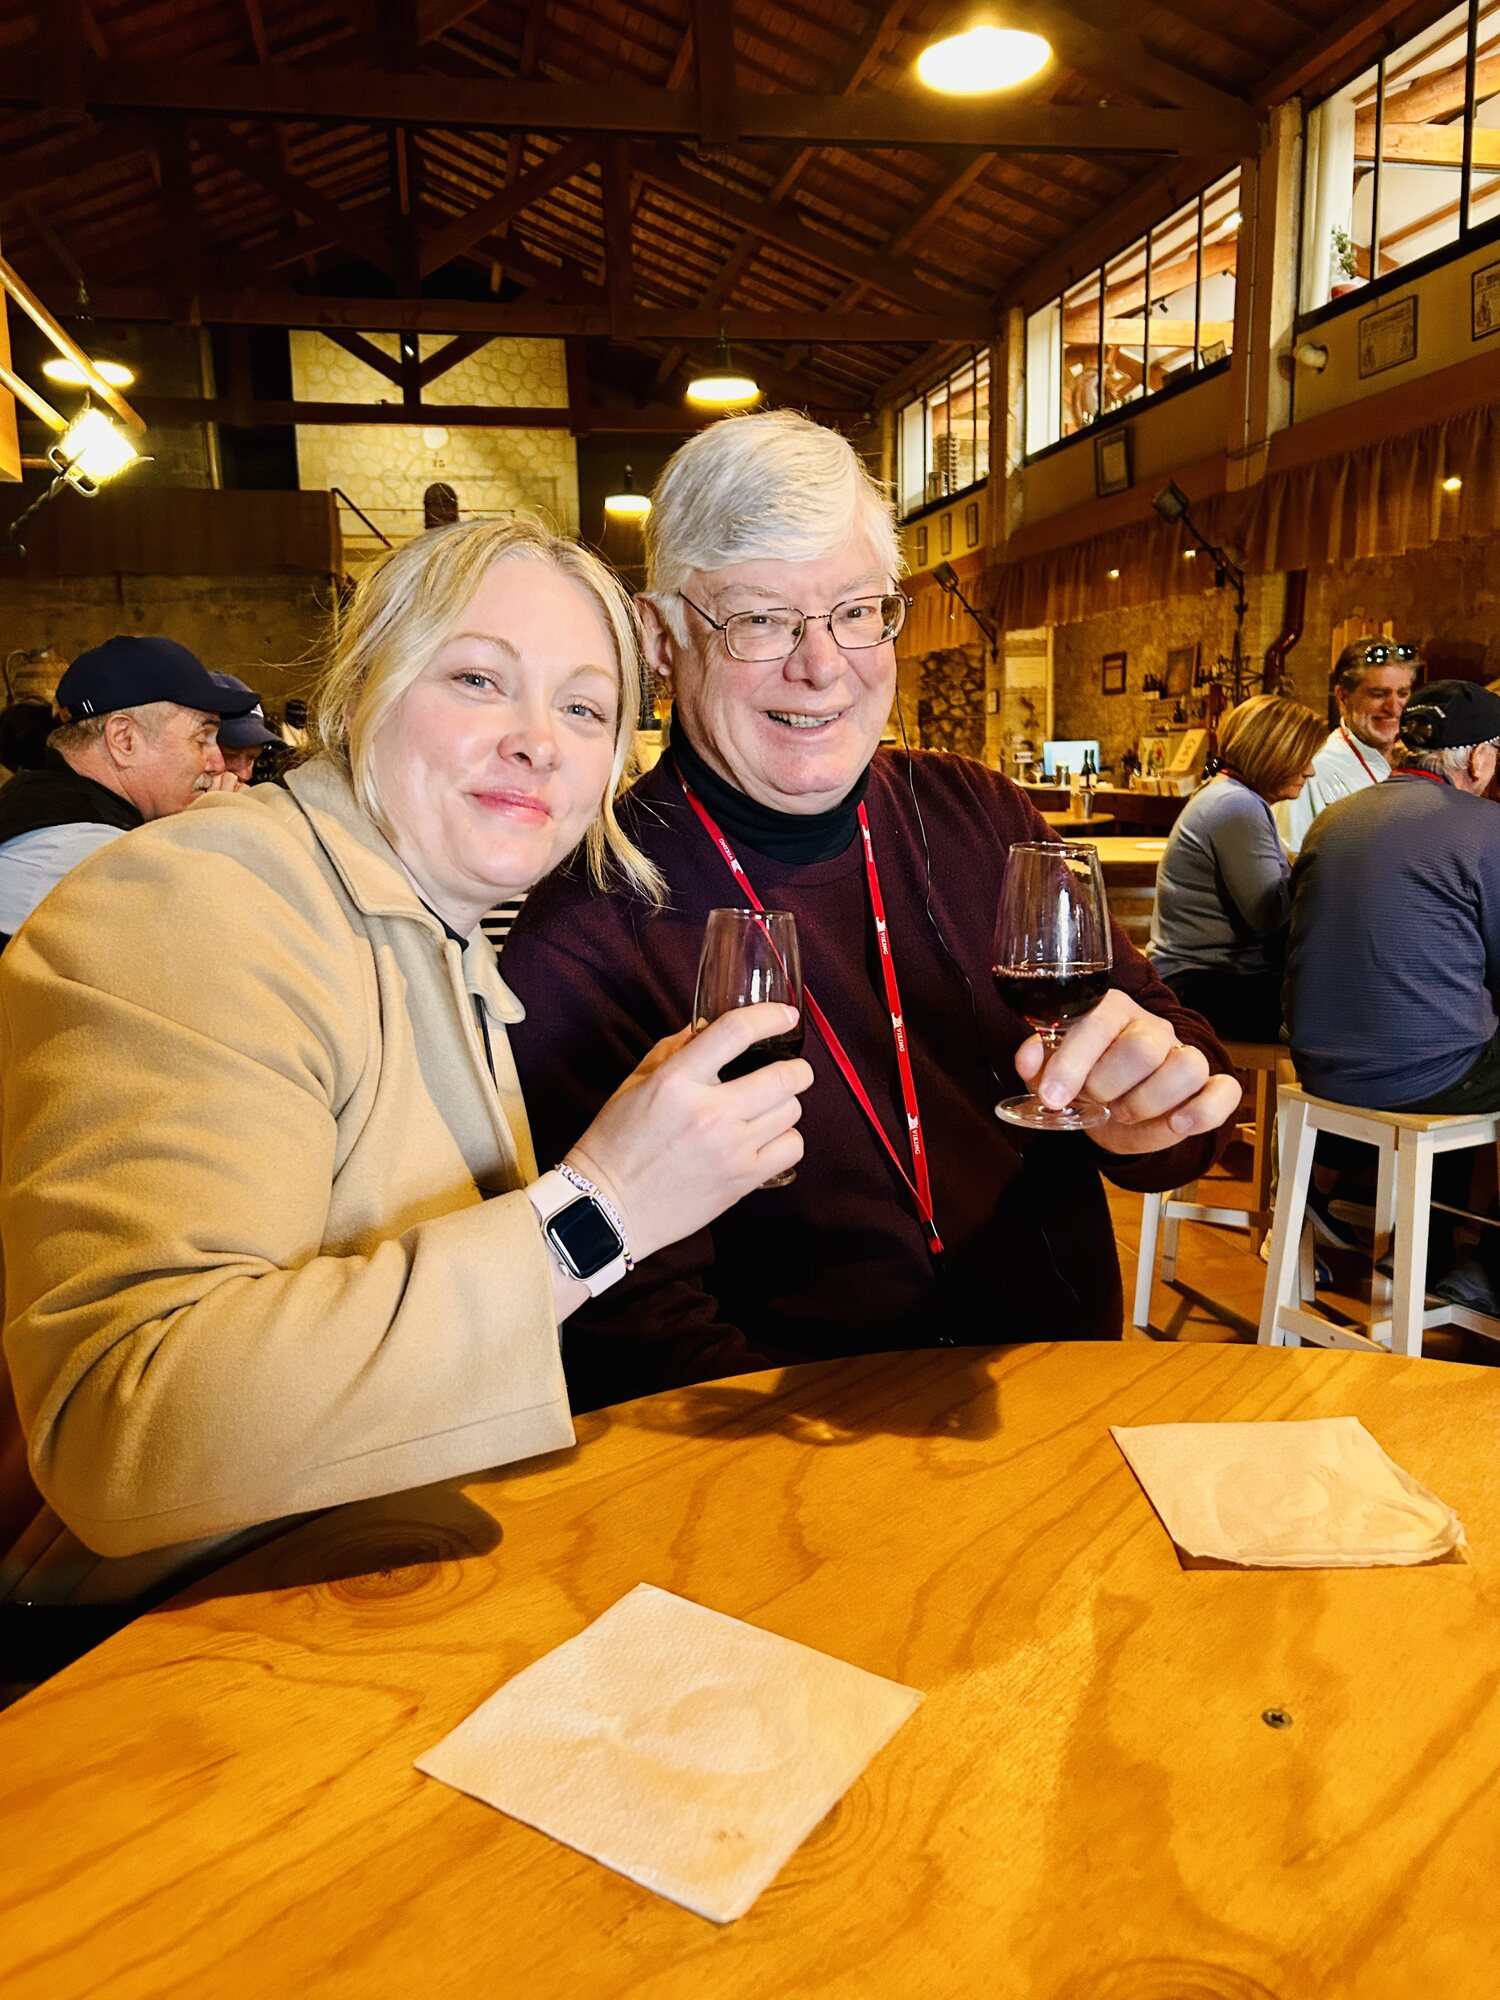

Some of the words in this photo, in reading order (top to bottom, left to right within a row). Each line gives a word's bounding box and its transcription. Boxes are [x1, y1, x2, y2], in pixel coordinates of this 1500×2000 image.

[718, 838, 733, 861] VIKING
[897, 1027, 905, 1052] VIKING
[912, 1129, 920, 1155] VIKING
